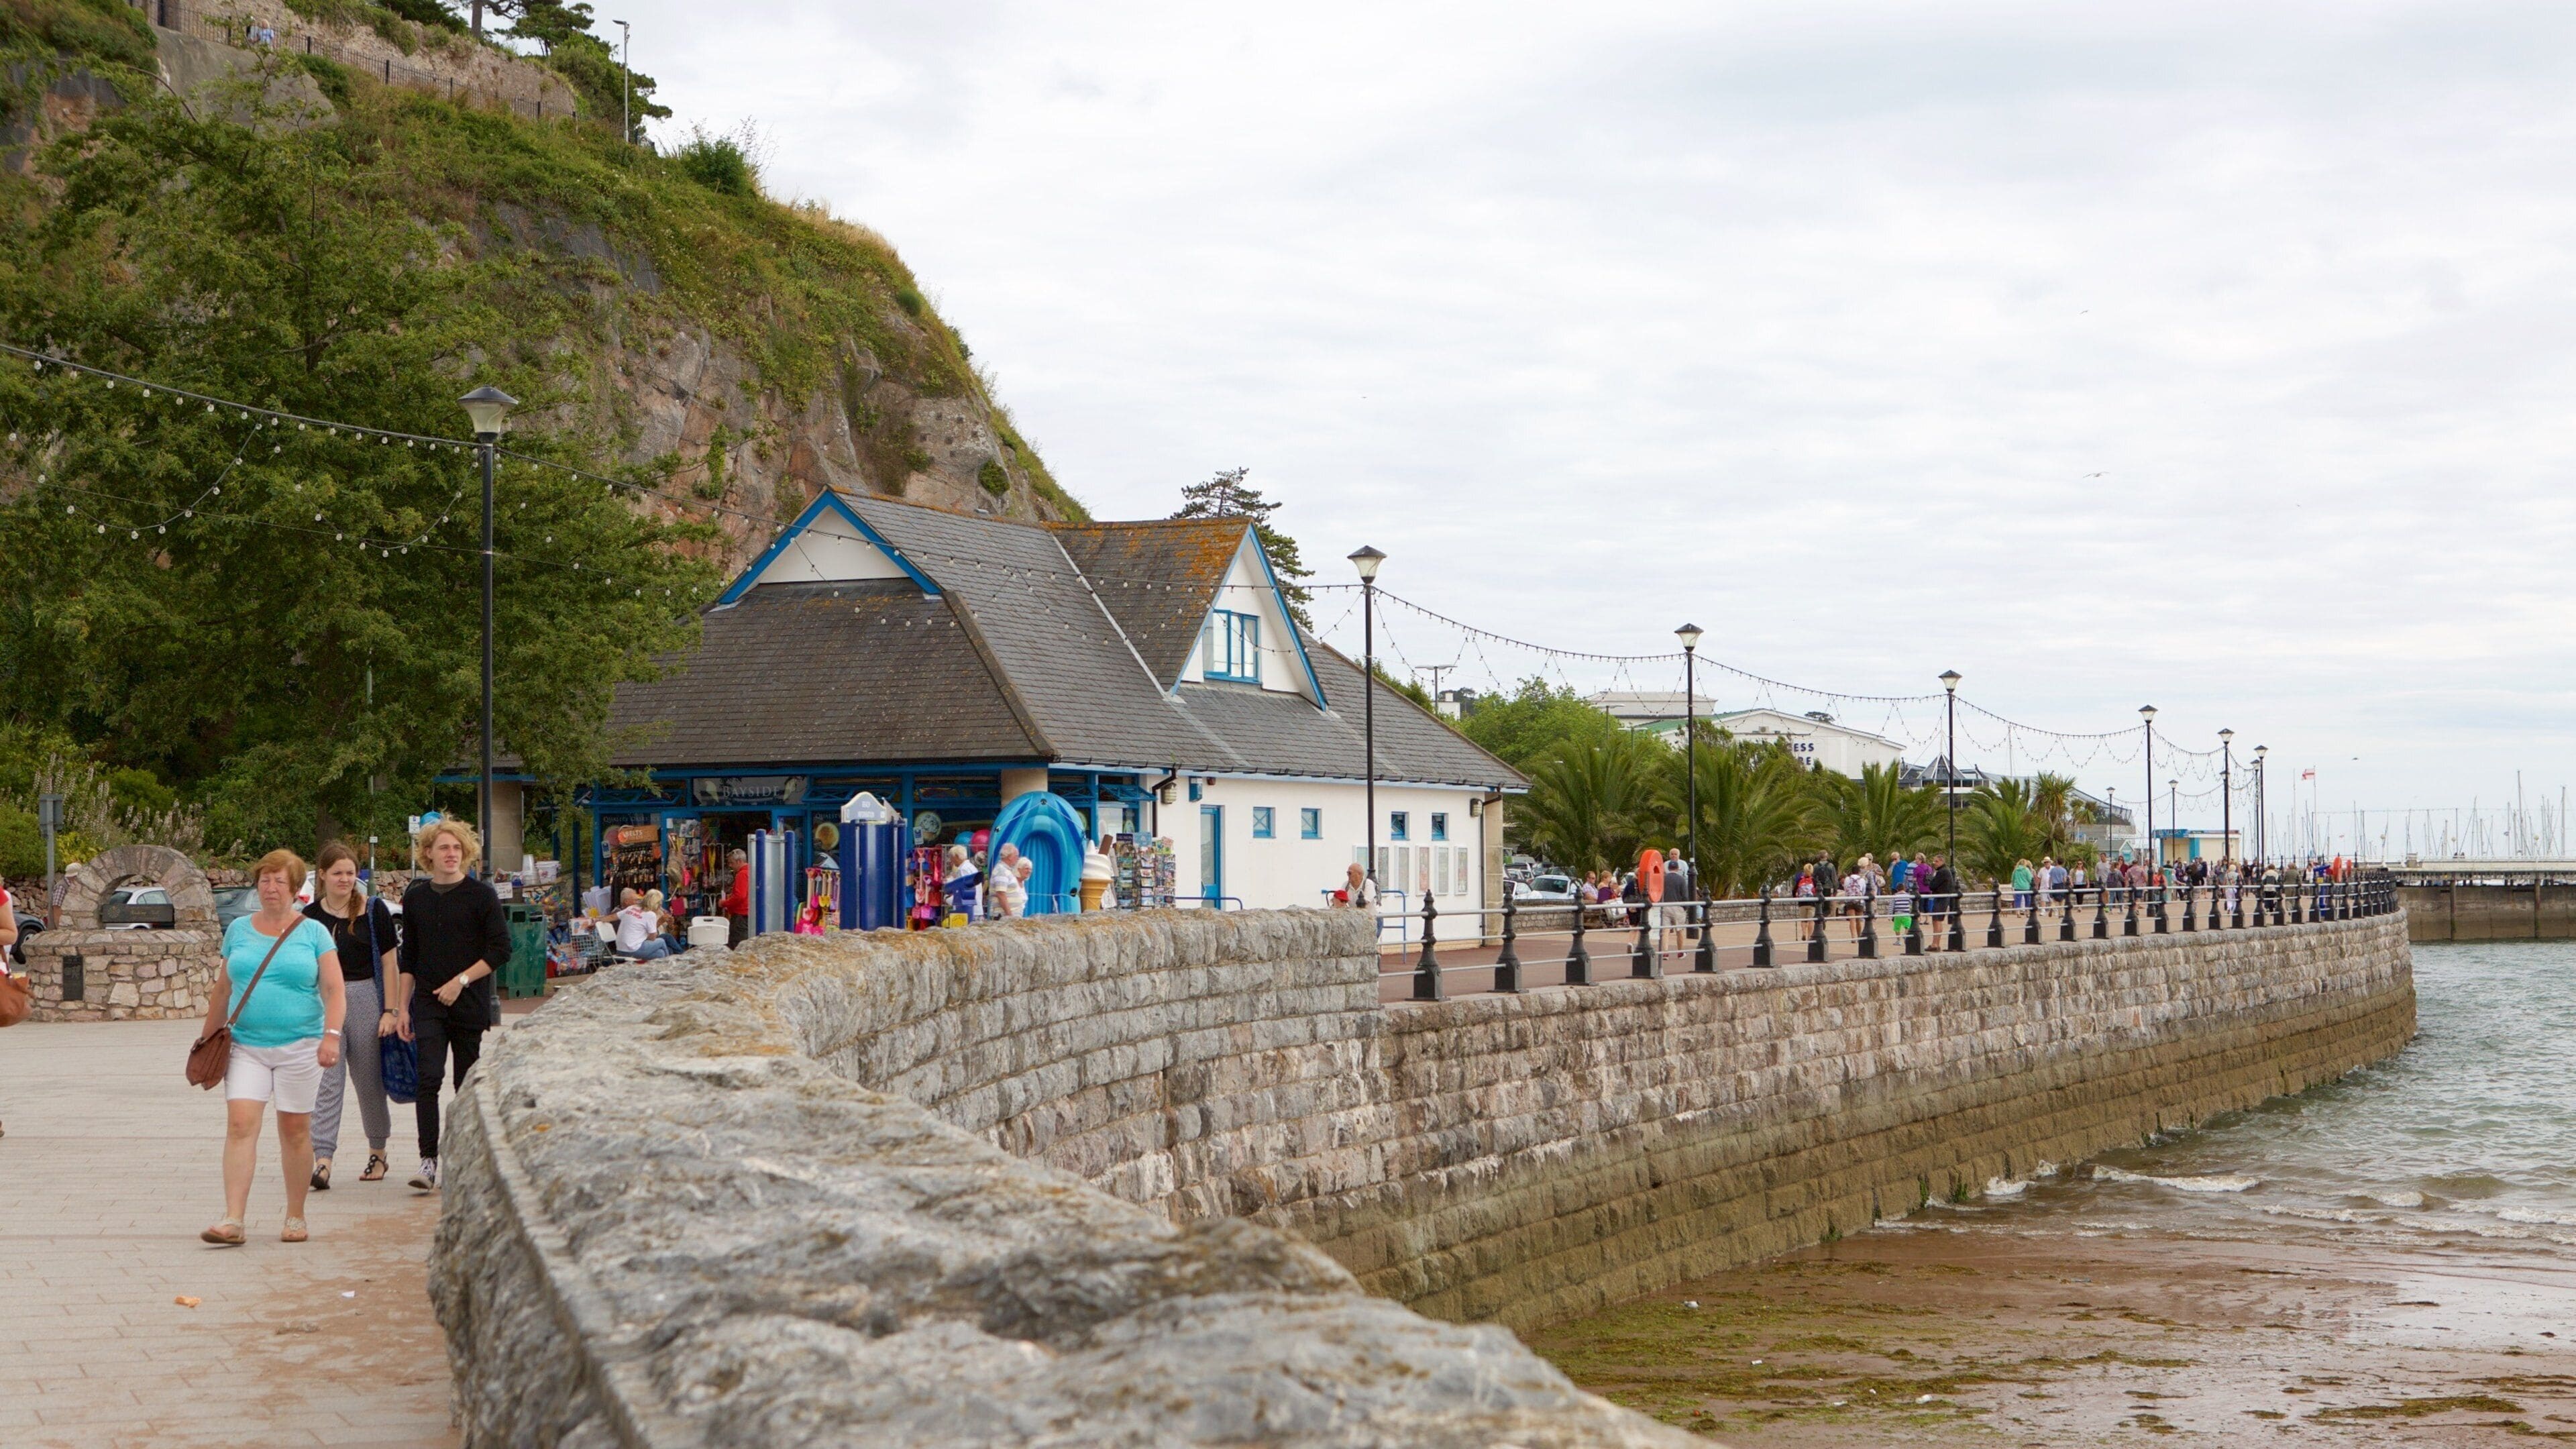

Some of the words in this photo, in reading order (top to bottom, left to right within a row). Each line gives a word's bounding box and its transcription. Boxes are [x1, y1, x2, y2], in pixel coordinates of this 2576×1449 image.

[1792, 743, 1815, 752] ESS
[723, 786, 780, 797] BAYSIDE
[625, 829, 643, 837] BELTS
